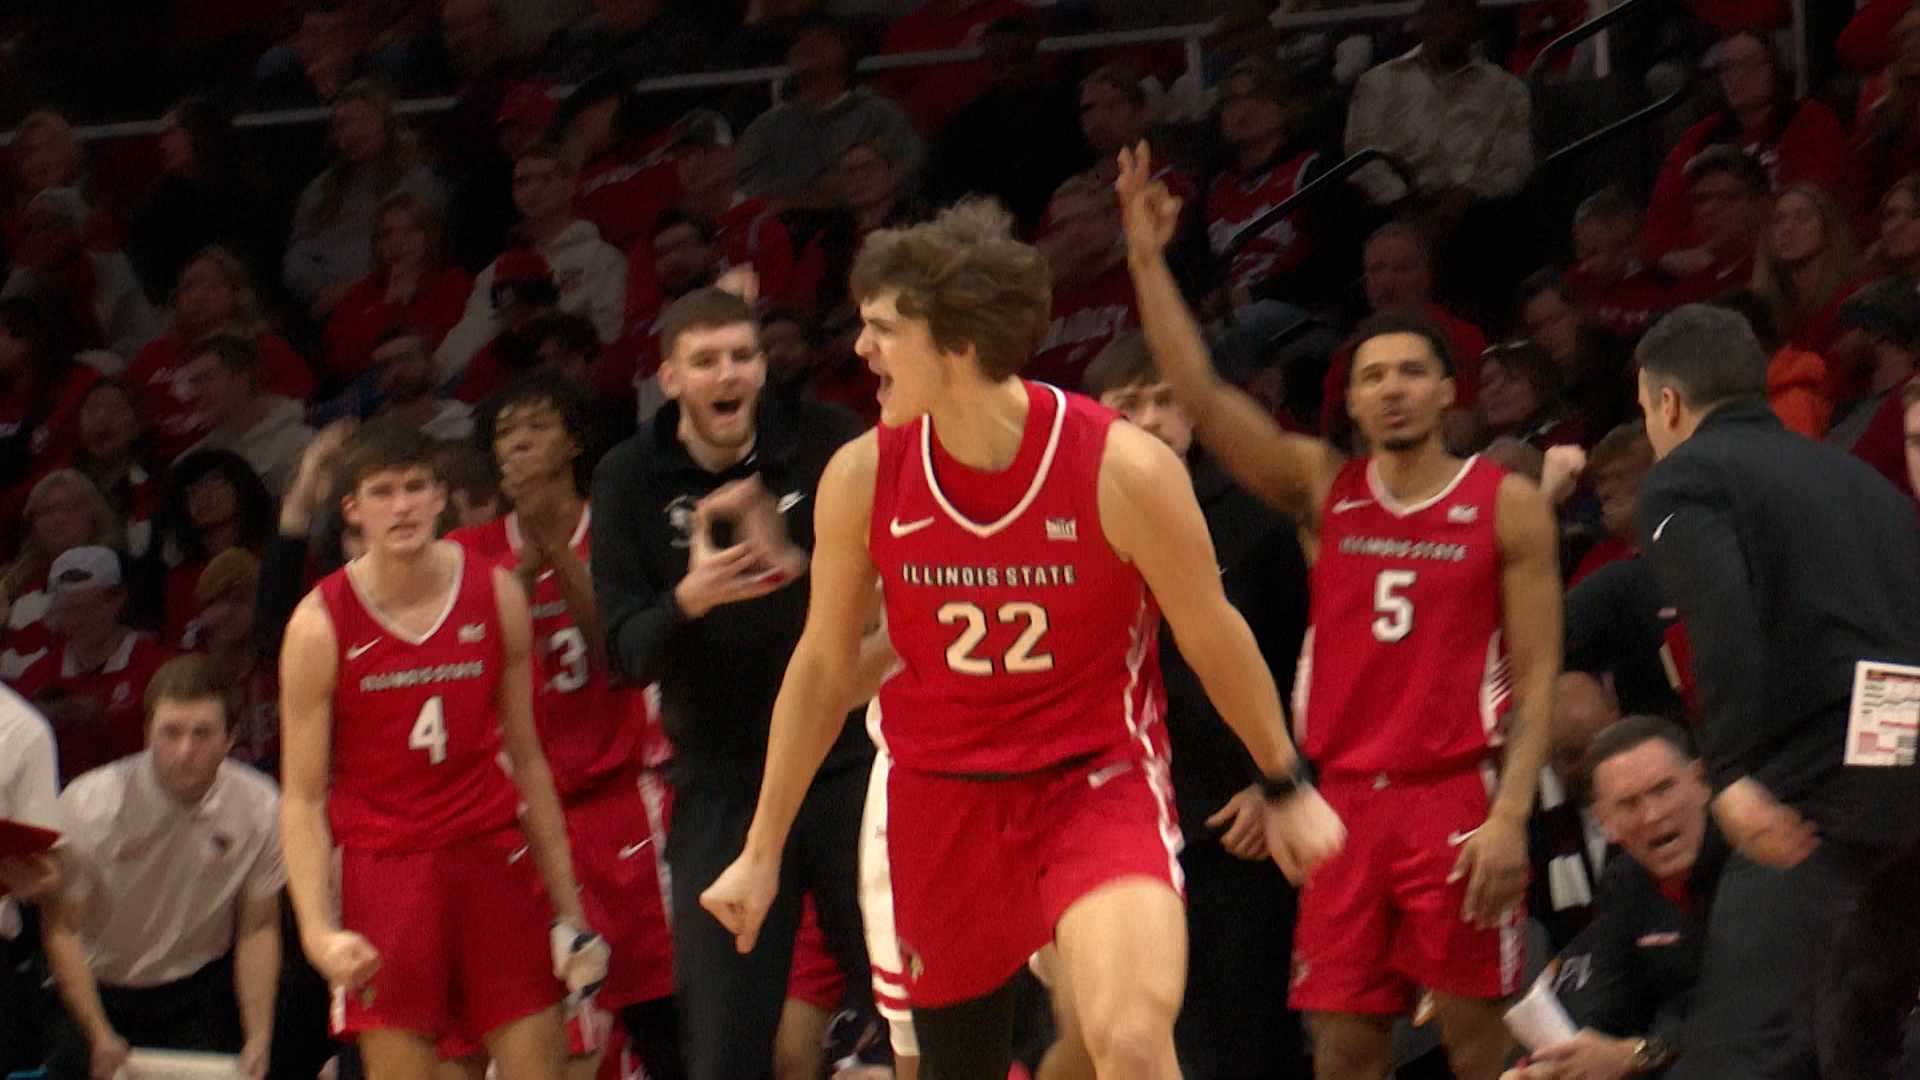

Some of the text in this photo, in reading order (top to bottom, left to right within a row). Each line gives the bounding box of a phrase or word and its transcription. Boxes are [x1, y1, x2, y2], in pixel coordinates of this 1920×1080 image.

[903, 563, 1076, 586] ILLINOIS STATE
[1371, 569, 1418, 642] 5
[937, 602, 1055, 676] 22
[408, 696, 447, 765] 4
